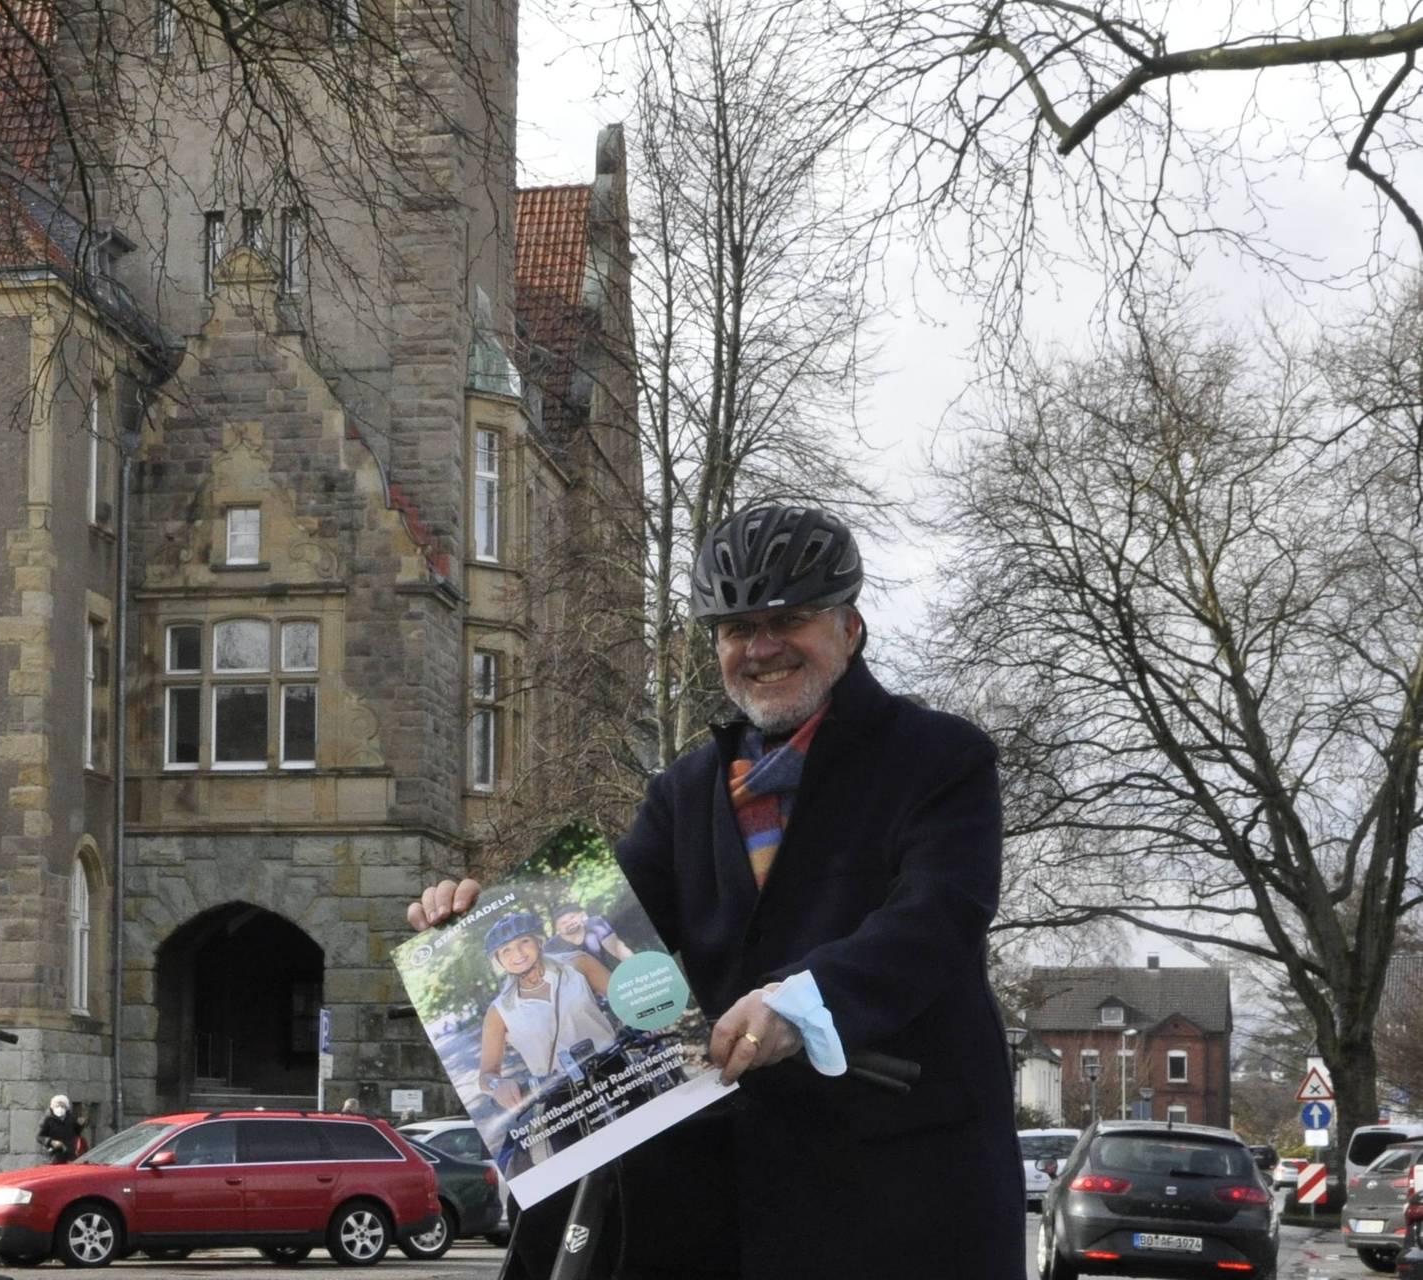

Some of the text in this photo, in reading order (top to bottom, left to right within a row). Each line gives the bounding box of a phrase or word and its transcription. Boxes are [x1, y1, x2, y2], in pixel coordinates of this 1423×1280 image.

[434, 892, 516, 949] STADTRADELN
[510, 1123, 530, 1140] Der
[529, 1089, 593, 1129] Wettbewerb
[591, 1079, 609, 1096] für
[520, 1111, 585, 1150] Klimaschutz
[585, 1098, 606, 1114] und
